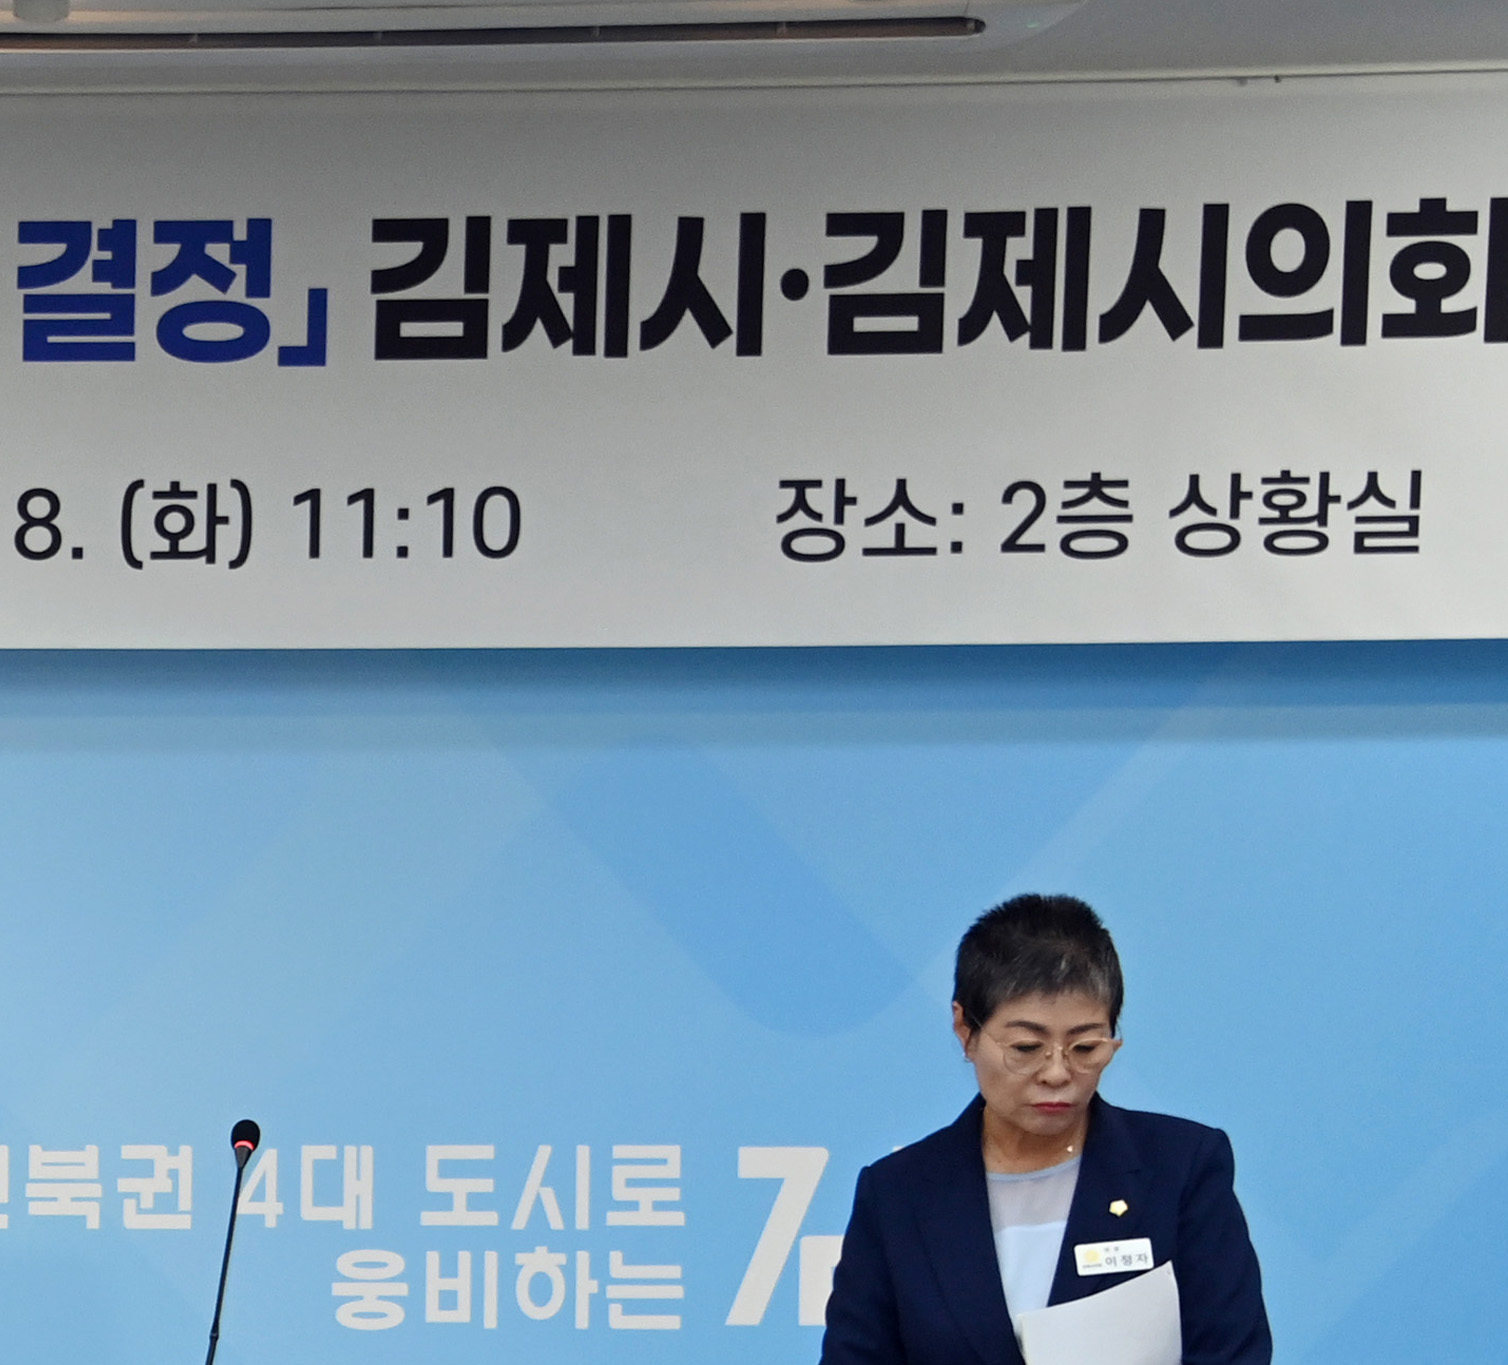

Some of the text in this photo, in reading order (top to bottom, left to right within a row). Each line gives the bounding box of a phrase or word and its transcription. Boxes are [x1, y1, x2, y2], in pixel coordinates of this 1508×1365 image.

[16, 217, 328, 367] 결정」
[14, 486, 86, 562] 8.
[120, 478, 255, 571] (화)
[290, 486, 523, 562] 11:10
[775, 467, 1426, 565] 장소: 2층 상황실
[236, 1144, 374, 1230] 4대
[419, 1144, 686, 1231] 도시로
[330, 1246, 685, 1331] 웅비하는
